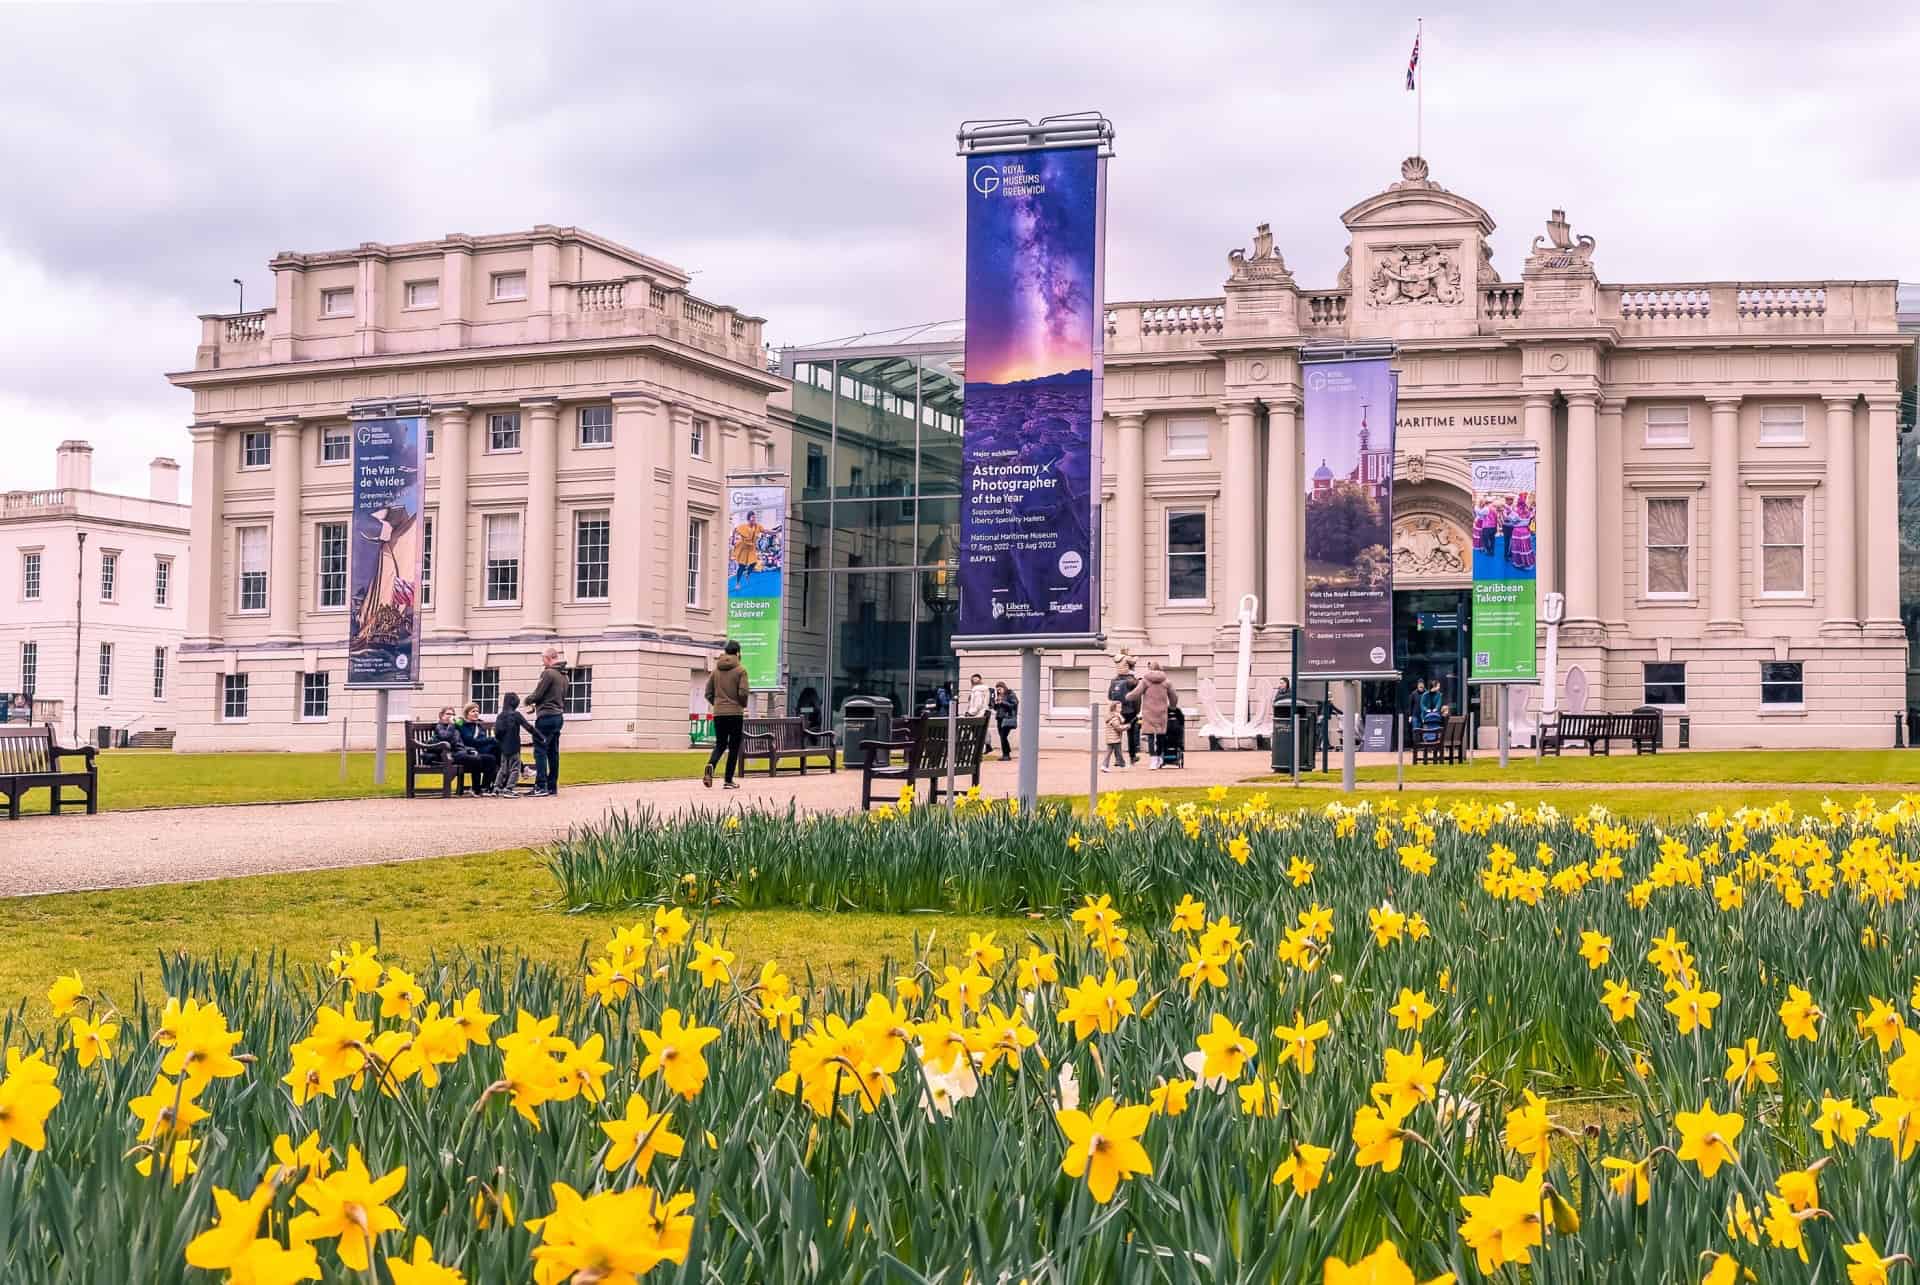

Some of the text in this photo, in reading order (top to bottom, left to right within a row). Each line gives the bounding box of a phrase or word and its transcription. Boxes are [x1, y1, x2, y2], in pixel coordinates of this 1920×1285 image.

[1003, 164, 1025, 175] ROYAL
[1003, 174, 1040, 185] MUSEUMS
[1003, 184, 1046, 197] GREENWICH
[1395, 415, 1518, 428] MARITIME MUSEUM
[360, 465, 395, 476] The Van
[972, 464, 1039, 477] Astronomy
[360, 475, 405, 488] de Veldes
[972, 475, 1058, 492] Photographer
[971, 493, 1024, 504] of the Year
[972, 508, 1005, 516] Supported
[971, 516, 994, 525] Liberty
[970, 531, 1058, 541] National Maritime Museum
[970, 543, 978, 551] 17
[978, 543, 993, 552] Sep
[1025, 542, 1037, 550] Aug
[1038, 541, 1057, 549] 2023
[1476, 584, 1524, 593] Caribbean
[1476, 594, 1518, 603] Takeover
[730, 600, 770, 609] Caribbean
[1006, 602, 1030, 611] Liberty
[730, 609, 764, 618] Takeover
